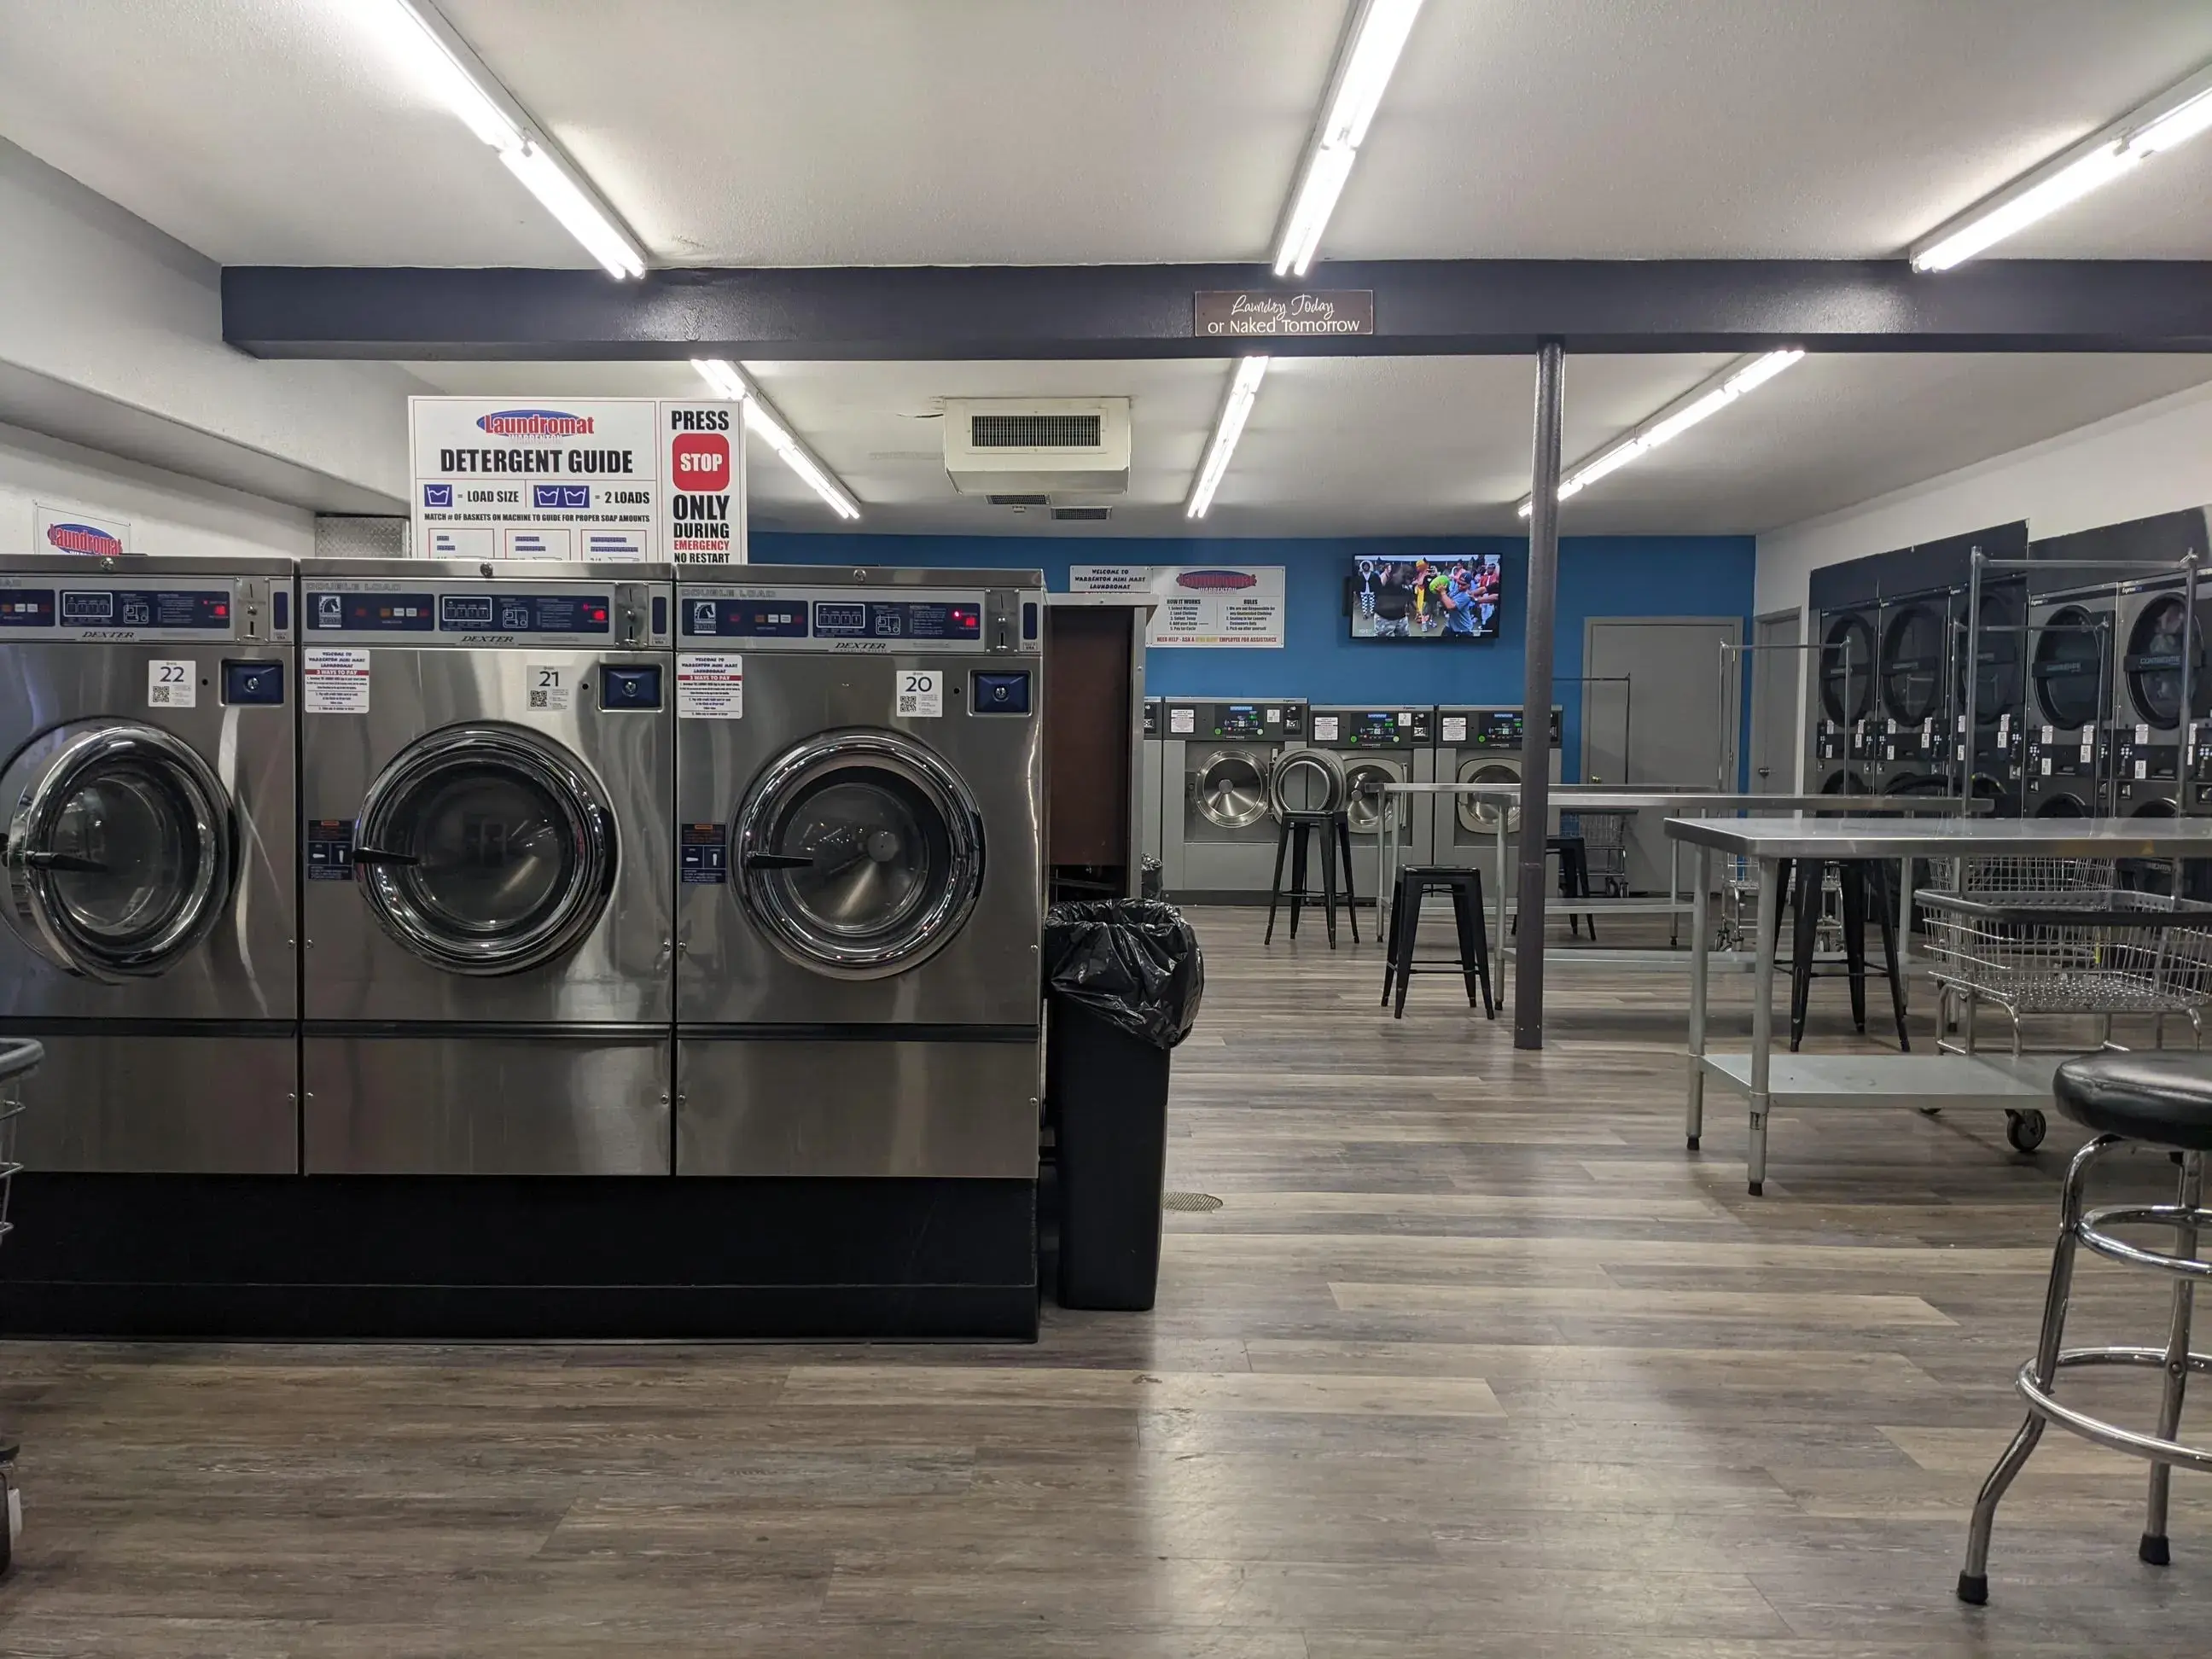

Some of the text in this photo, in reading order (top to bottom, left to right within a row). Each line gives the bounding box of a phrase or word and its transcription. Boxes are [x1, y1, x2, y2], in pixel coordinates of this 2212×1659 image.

[1231, 294, 1335, 321] Laundry Today
[1208, 317, 1360, 334] or Naked Tomorrow
[484, 414, 595, 434] Laundromat
[671, 410, 730, 431] PRESS
[440, 449, 633, 474] DETERGENT GUIDE
[680, 452, 723, 472] STOP
[467, 491, 496, 503] LOAD
[497, 491, 520, 503] SIZE
[605, 492, 612, 504] 2
[614, 492, 650, 504] LOADS
[672, 494, 731, 521] ONLY
[619, 515, 650, 523] AMOUNTS
[673, 522, 730, 538] DURING
[49, 523, 123, 556] Laundromat
[674, 539, 730, 551] EMERGENCY
[674, 552, 730, 564] NO RESTART
[160, 666, 184, 683] 22
[538, 671, 559, 687] 21
[905, 676, 932, 692] 20
